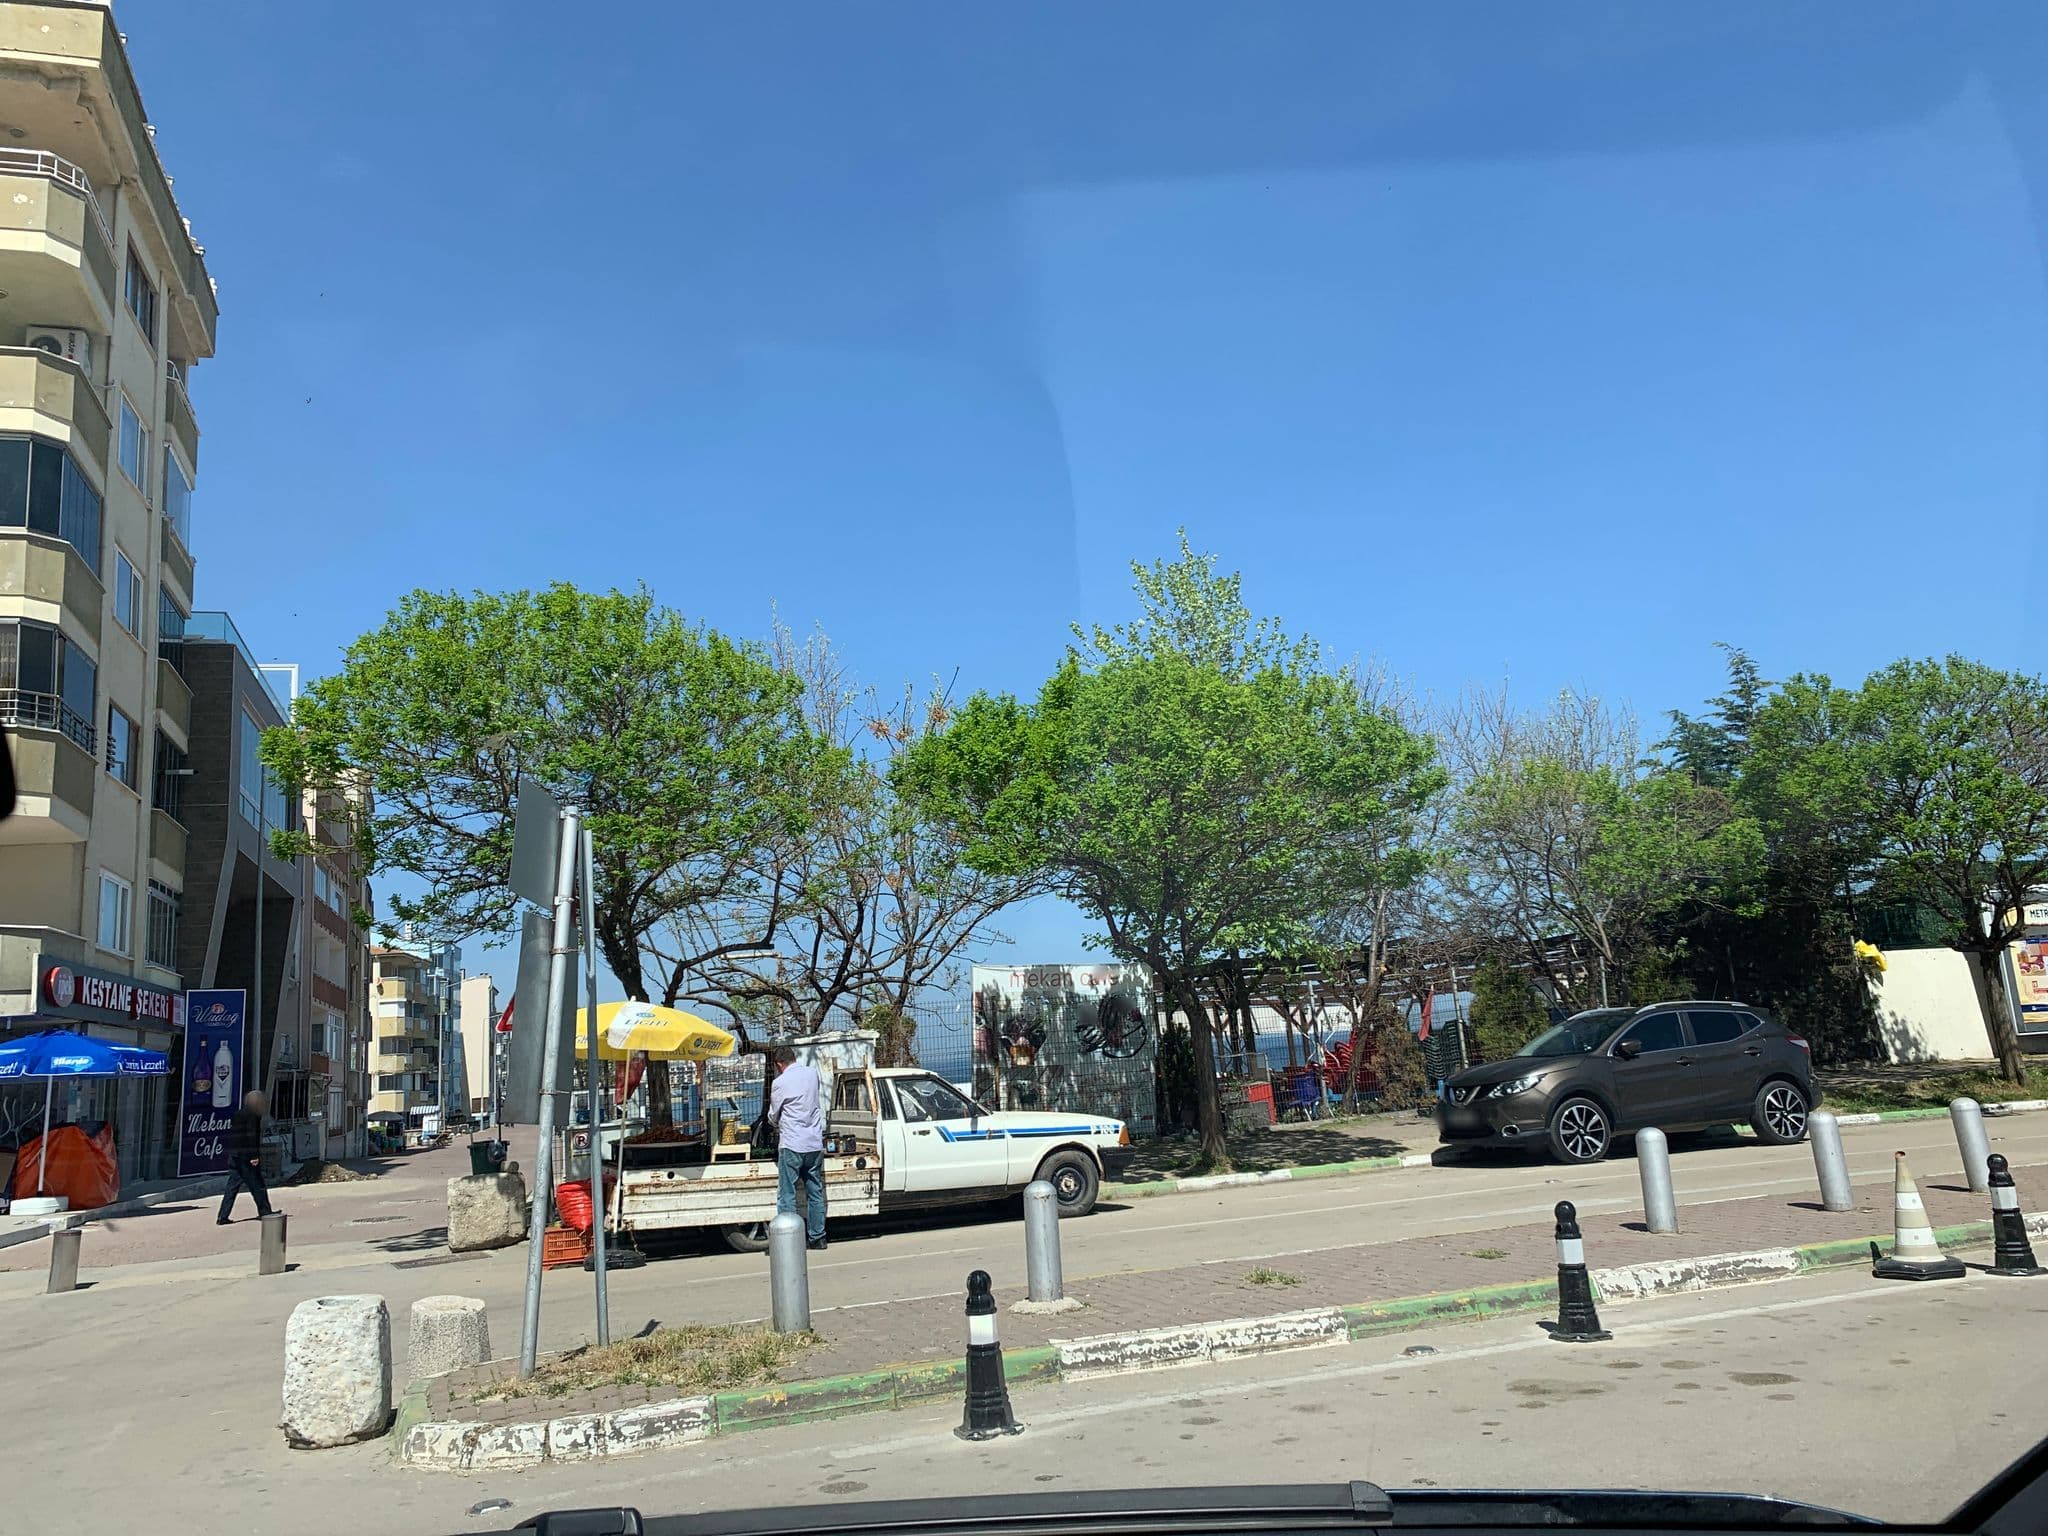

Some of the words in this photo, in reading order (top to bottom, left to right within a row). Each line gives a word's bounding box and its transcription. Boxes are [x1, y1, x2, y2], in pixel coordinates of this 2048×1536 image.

[82, 976, 132, 1012] KESTANE
[188, 1112, 232, 1134] Mekan
[194, 1135, 224, 1160] Cafe
